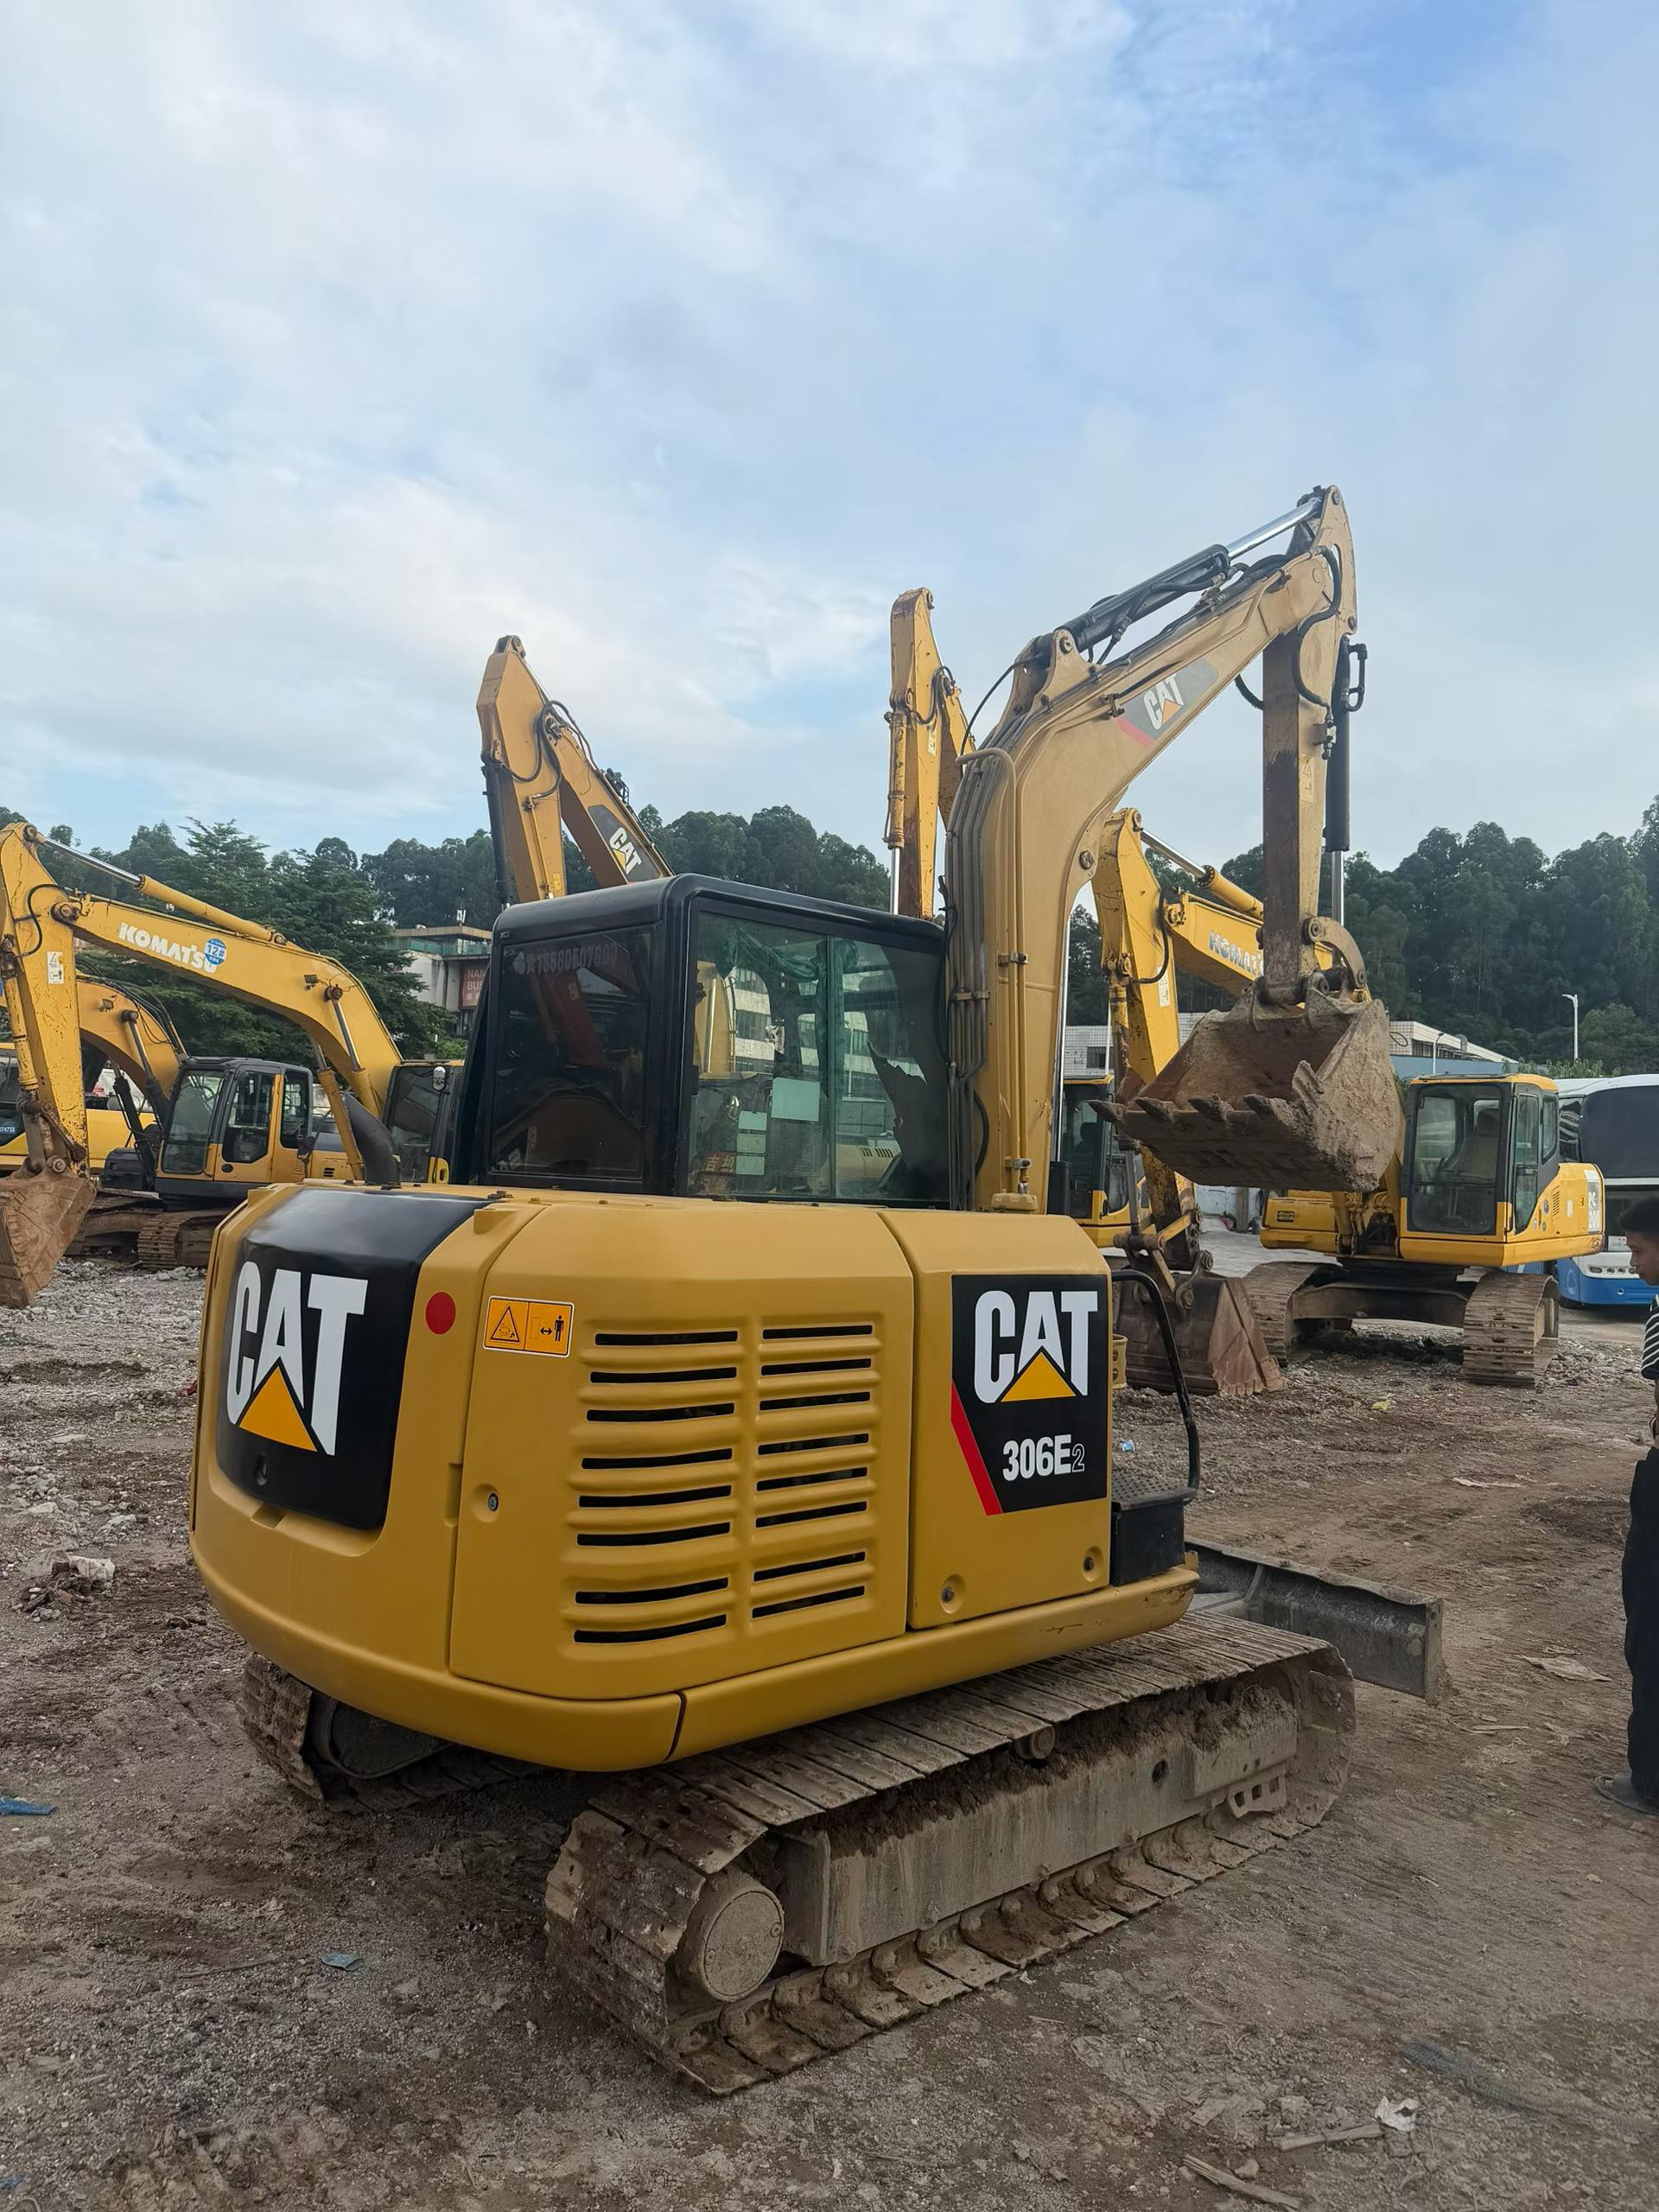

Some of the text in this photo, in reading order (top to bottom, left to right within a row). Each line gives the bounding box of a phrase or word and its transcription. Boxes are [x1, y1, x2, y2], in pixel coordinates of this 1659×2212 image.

[1143, 673, 1185, 730] CAT
[609, 827, 642, 875] CAT
[226, 1261, 369, 1457] CAT
[974, 1290, 1098, 1404] CAT
[1002, 1433, 1085, 1482] 306E2
